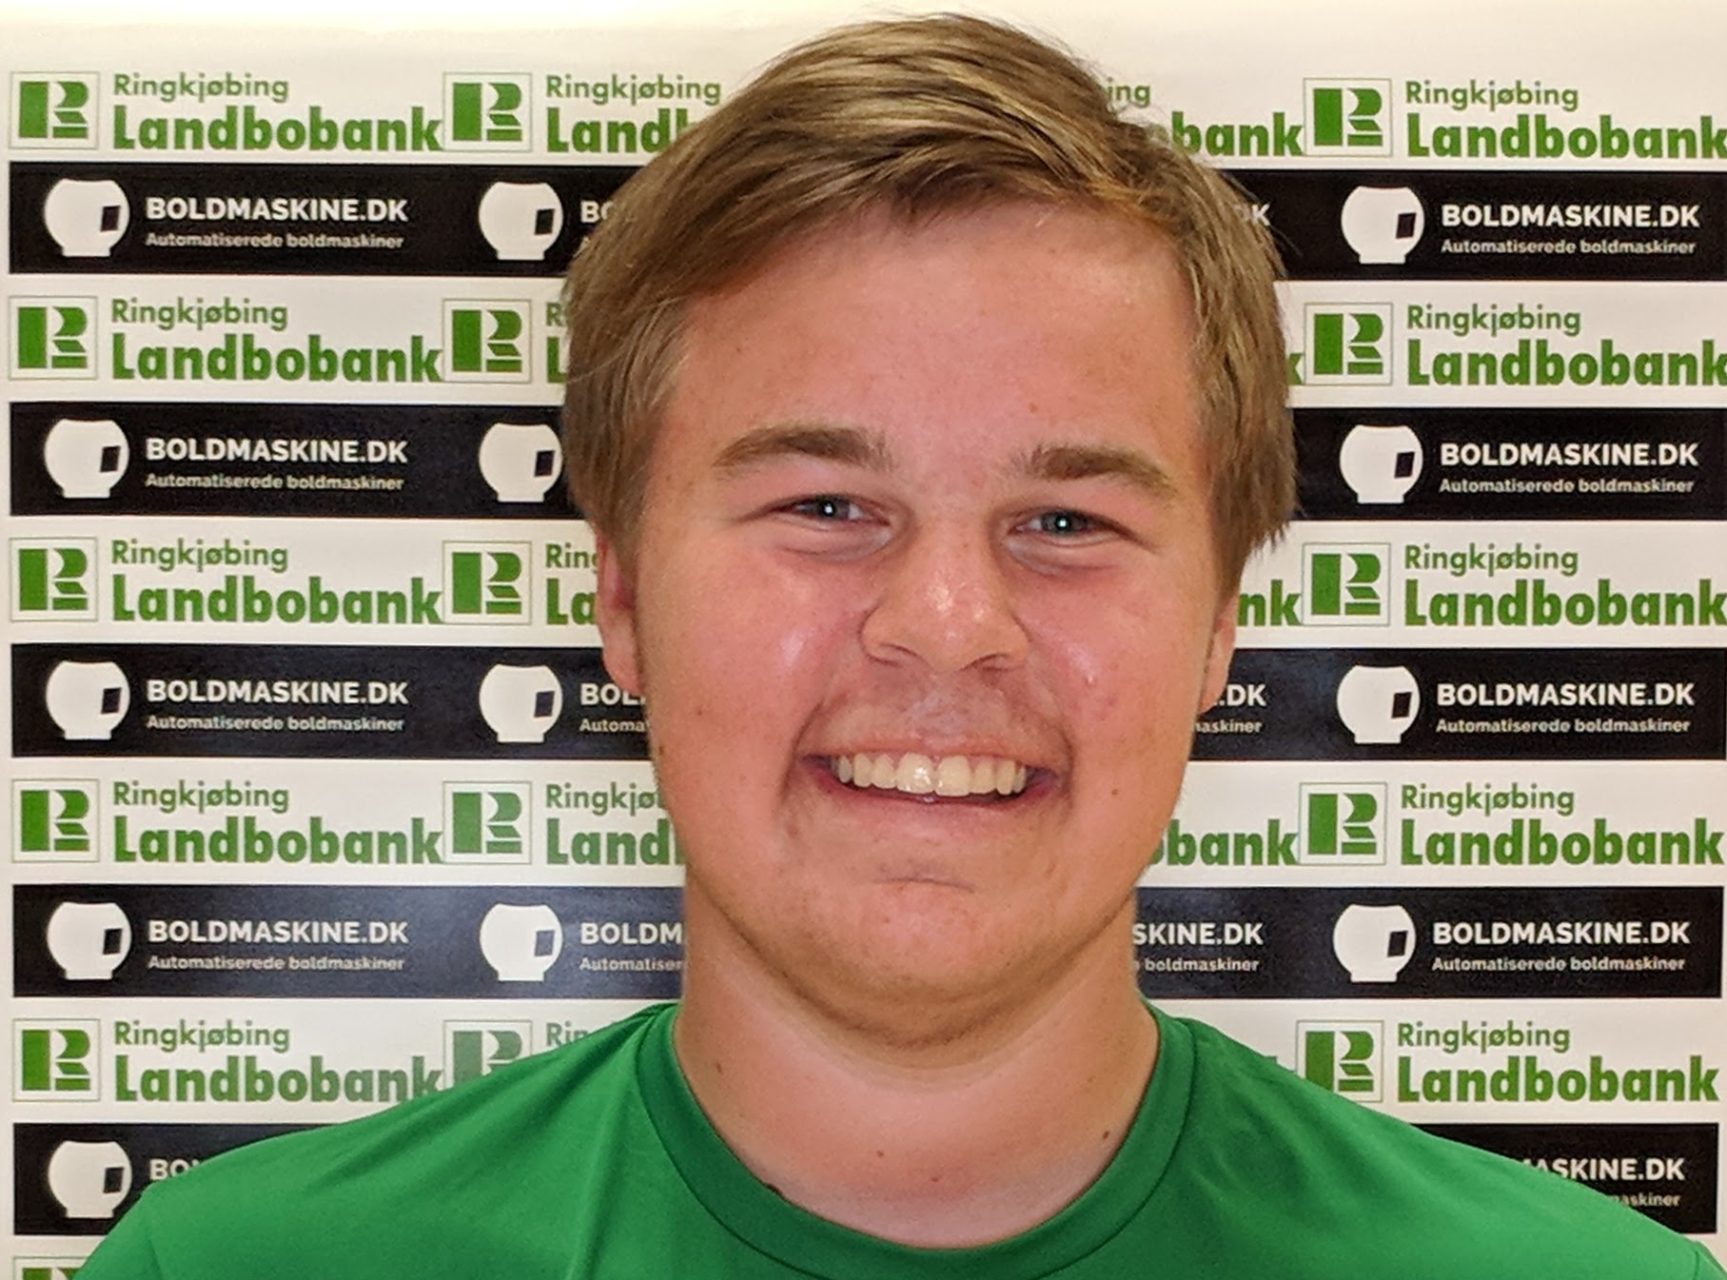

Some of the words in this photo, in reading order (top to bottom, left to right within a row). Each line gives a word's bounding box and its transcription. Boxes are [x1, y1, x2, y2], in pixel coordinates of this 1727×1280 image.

[113, 73, 288, 101] Ringkjøbing
[546, 74, 721, 106] Ringkjøbing
[1405, 80, 1579, 110] Ringkjøbing
[113, 105, 441, 151] Landbobank
[547, 107, 688, 153] Land
[1171, 111, 1302, 156] bank
[1407, 113, 1727, 159] Landbobank
[146, 197, 408, 222] BOLDMASKINE.DK
[1442, 204, 1700, 227] BOLDMASKINE.DK
[146, 232, 283, 248] Automatiserede
[287, 233, 404, 249] boldmaskiner
[1441, 239, 1576, 254] Automatiserede
[1579, 239, 1696, 254] boldmaskiner
[112, 297, 288, 330] Ringkjøbing
[1407, 304, 1581, 336] Ringkjøbing
[112, 333, 441, 383] Landbobank
[1408, 339, 1727, 386] Landbobank
[146, 437, 408, 463] BOLDMASKINE.DK
[1440, 443, 1698, 466] BOLDMASKINE.DK
[145, 473, 283, 489] Automatiserede
[287, 475, 404, 490] boldmaskiner
[1439, 478, 1575, 493] Automatiserede
[1578, 478, 1694, 493] boldmaskiner
[112, 539, 288, 573] Ringkjøbing
[1404, 544, 1579, 576] Ringkjøbing
[112, 575, 441, 624] Landbobank
[1405, 579, 1727, 627] Landbobank
[147, 679, 409, 704] BOLDMASKINE.DK
[1437, 682, 1694, 706] BOLDMASKINE.DK
[147, 715, 283, 730] Automatiserede
[287, 716, 404, 731] boldmaskiner
[580, 719, 650, 732] Automa
[1435, 718, 1571, 733] Automatiserede
[1574, 718, 1691, 733] boldmaskiner
[113, 781, 289, 814] Ringkjøbing
[546, 781, 665, 816] Ringkjø
[1401, 784, 1575, 816] Ringkjøbing
[114, 816, 441, 864] Landbobank
[1401, 818, 1725, 866] Landbobank
[149, 920, 409, 944] BOLDMASKINE.DK
[580, 923, 682, 944] BOLDM
[1132, 922, 1264, 945] SKINE.DK
[1433, 921, 1690, 945] BOLDMASKINE.DK
[148, 955, 285, 970] Automatiserede
[288, 956, 405, 970] boldmaskiner
[579, 957, 684, 971] Automatiser
[1144, 957, 1260, 972] boldmaskiner
[1431, 956, 1567, 972] Automatiserede
[1570, 956, 1686, 971] boldmaskiner
[114, 1020, 289, 1053] Ringkjøbing
[1397, 1021, 1571, 1053] Ringkjøbing
[115, 1055, 441, 1102] Landbobank
[1397, 1055, 1720, 1102] Landbobank
